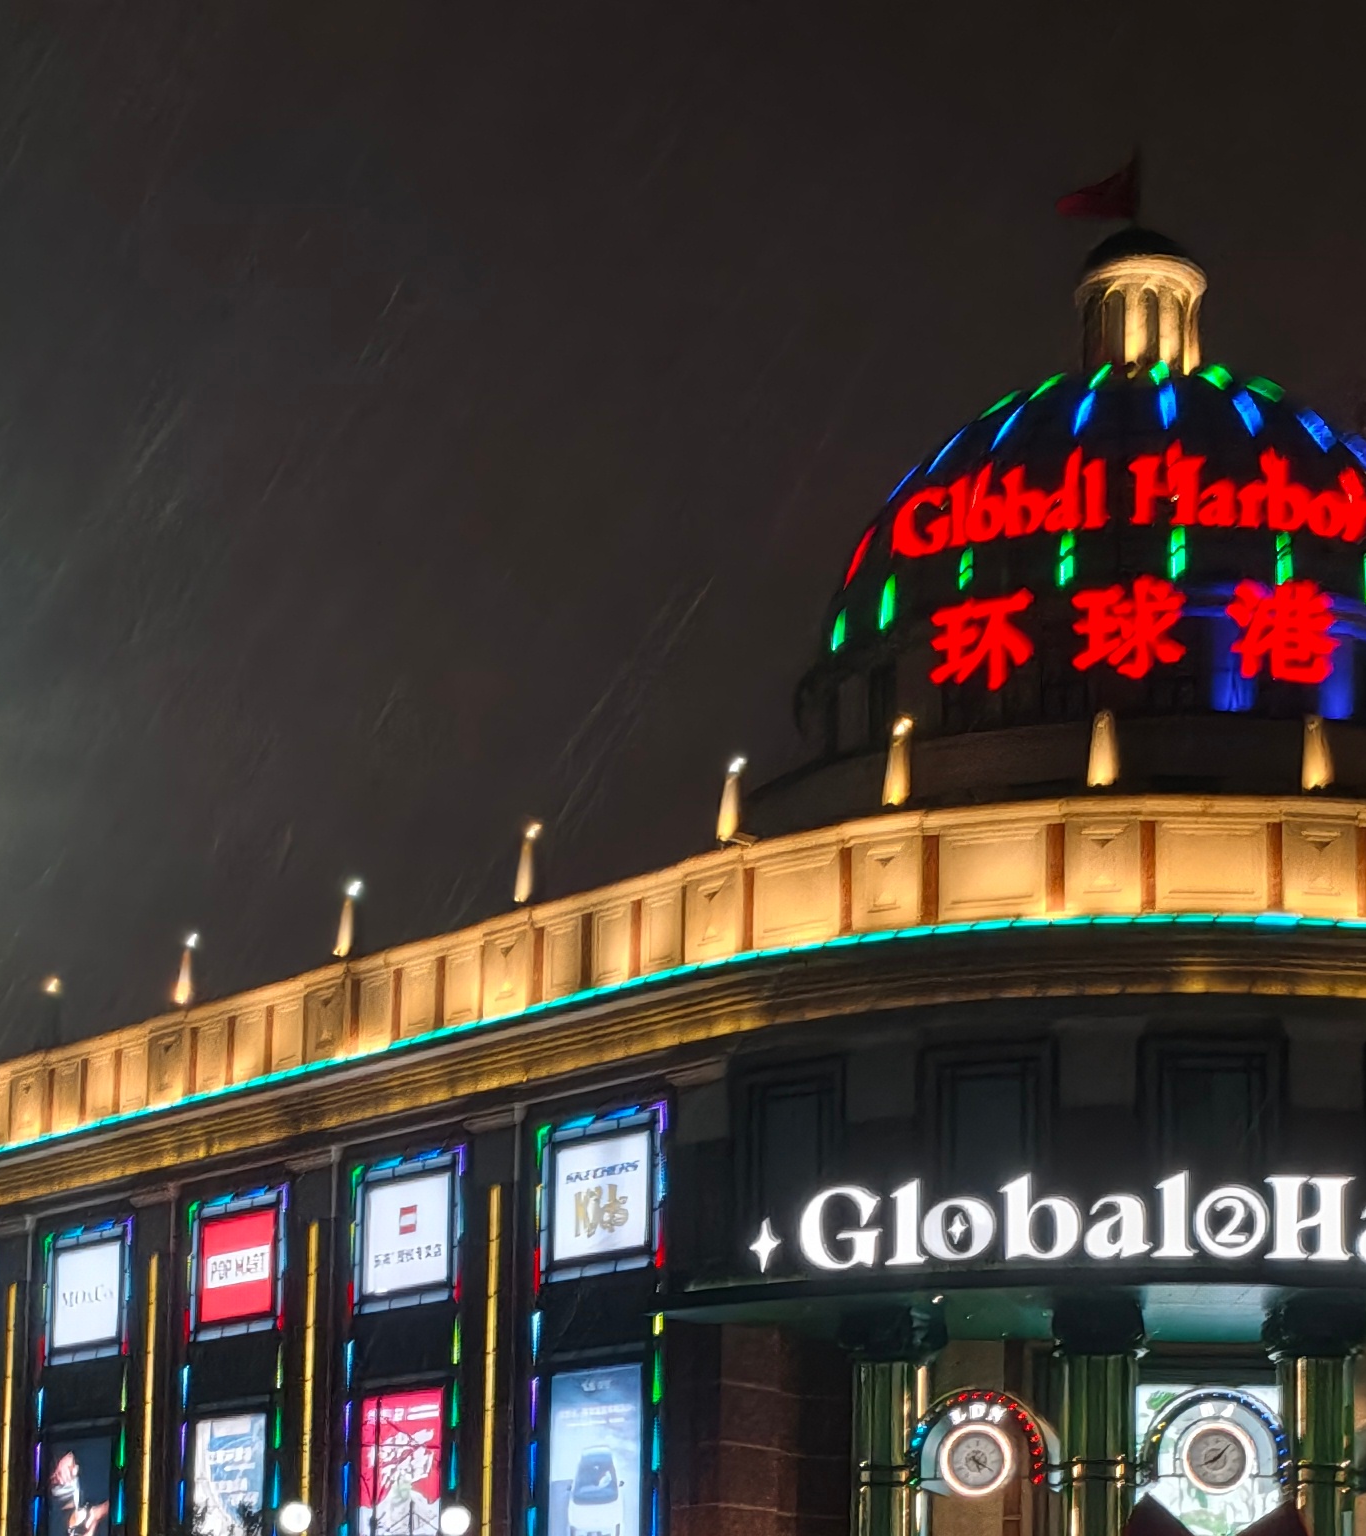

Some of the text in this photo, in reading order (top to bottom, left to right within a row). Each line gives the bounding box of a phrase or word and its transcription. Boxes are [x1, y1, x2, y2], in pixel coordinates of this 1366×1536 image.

[892, 446, 1110, 559] Global
[930, 576, 1339, 691] 环球港
